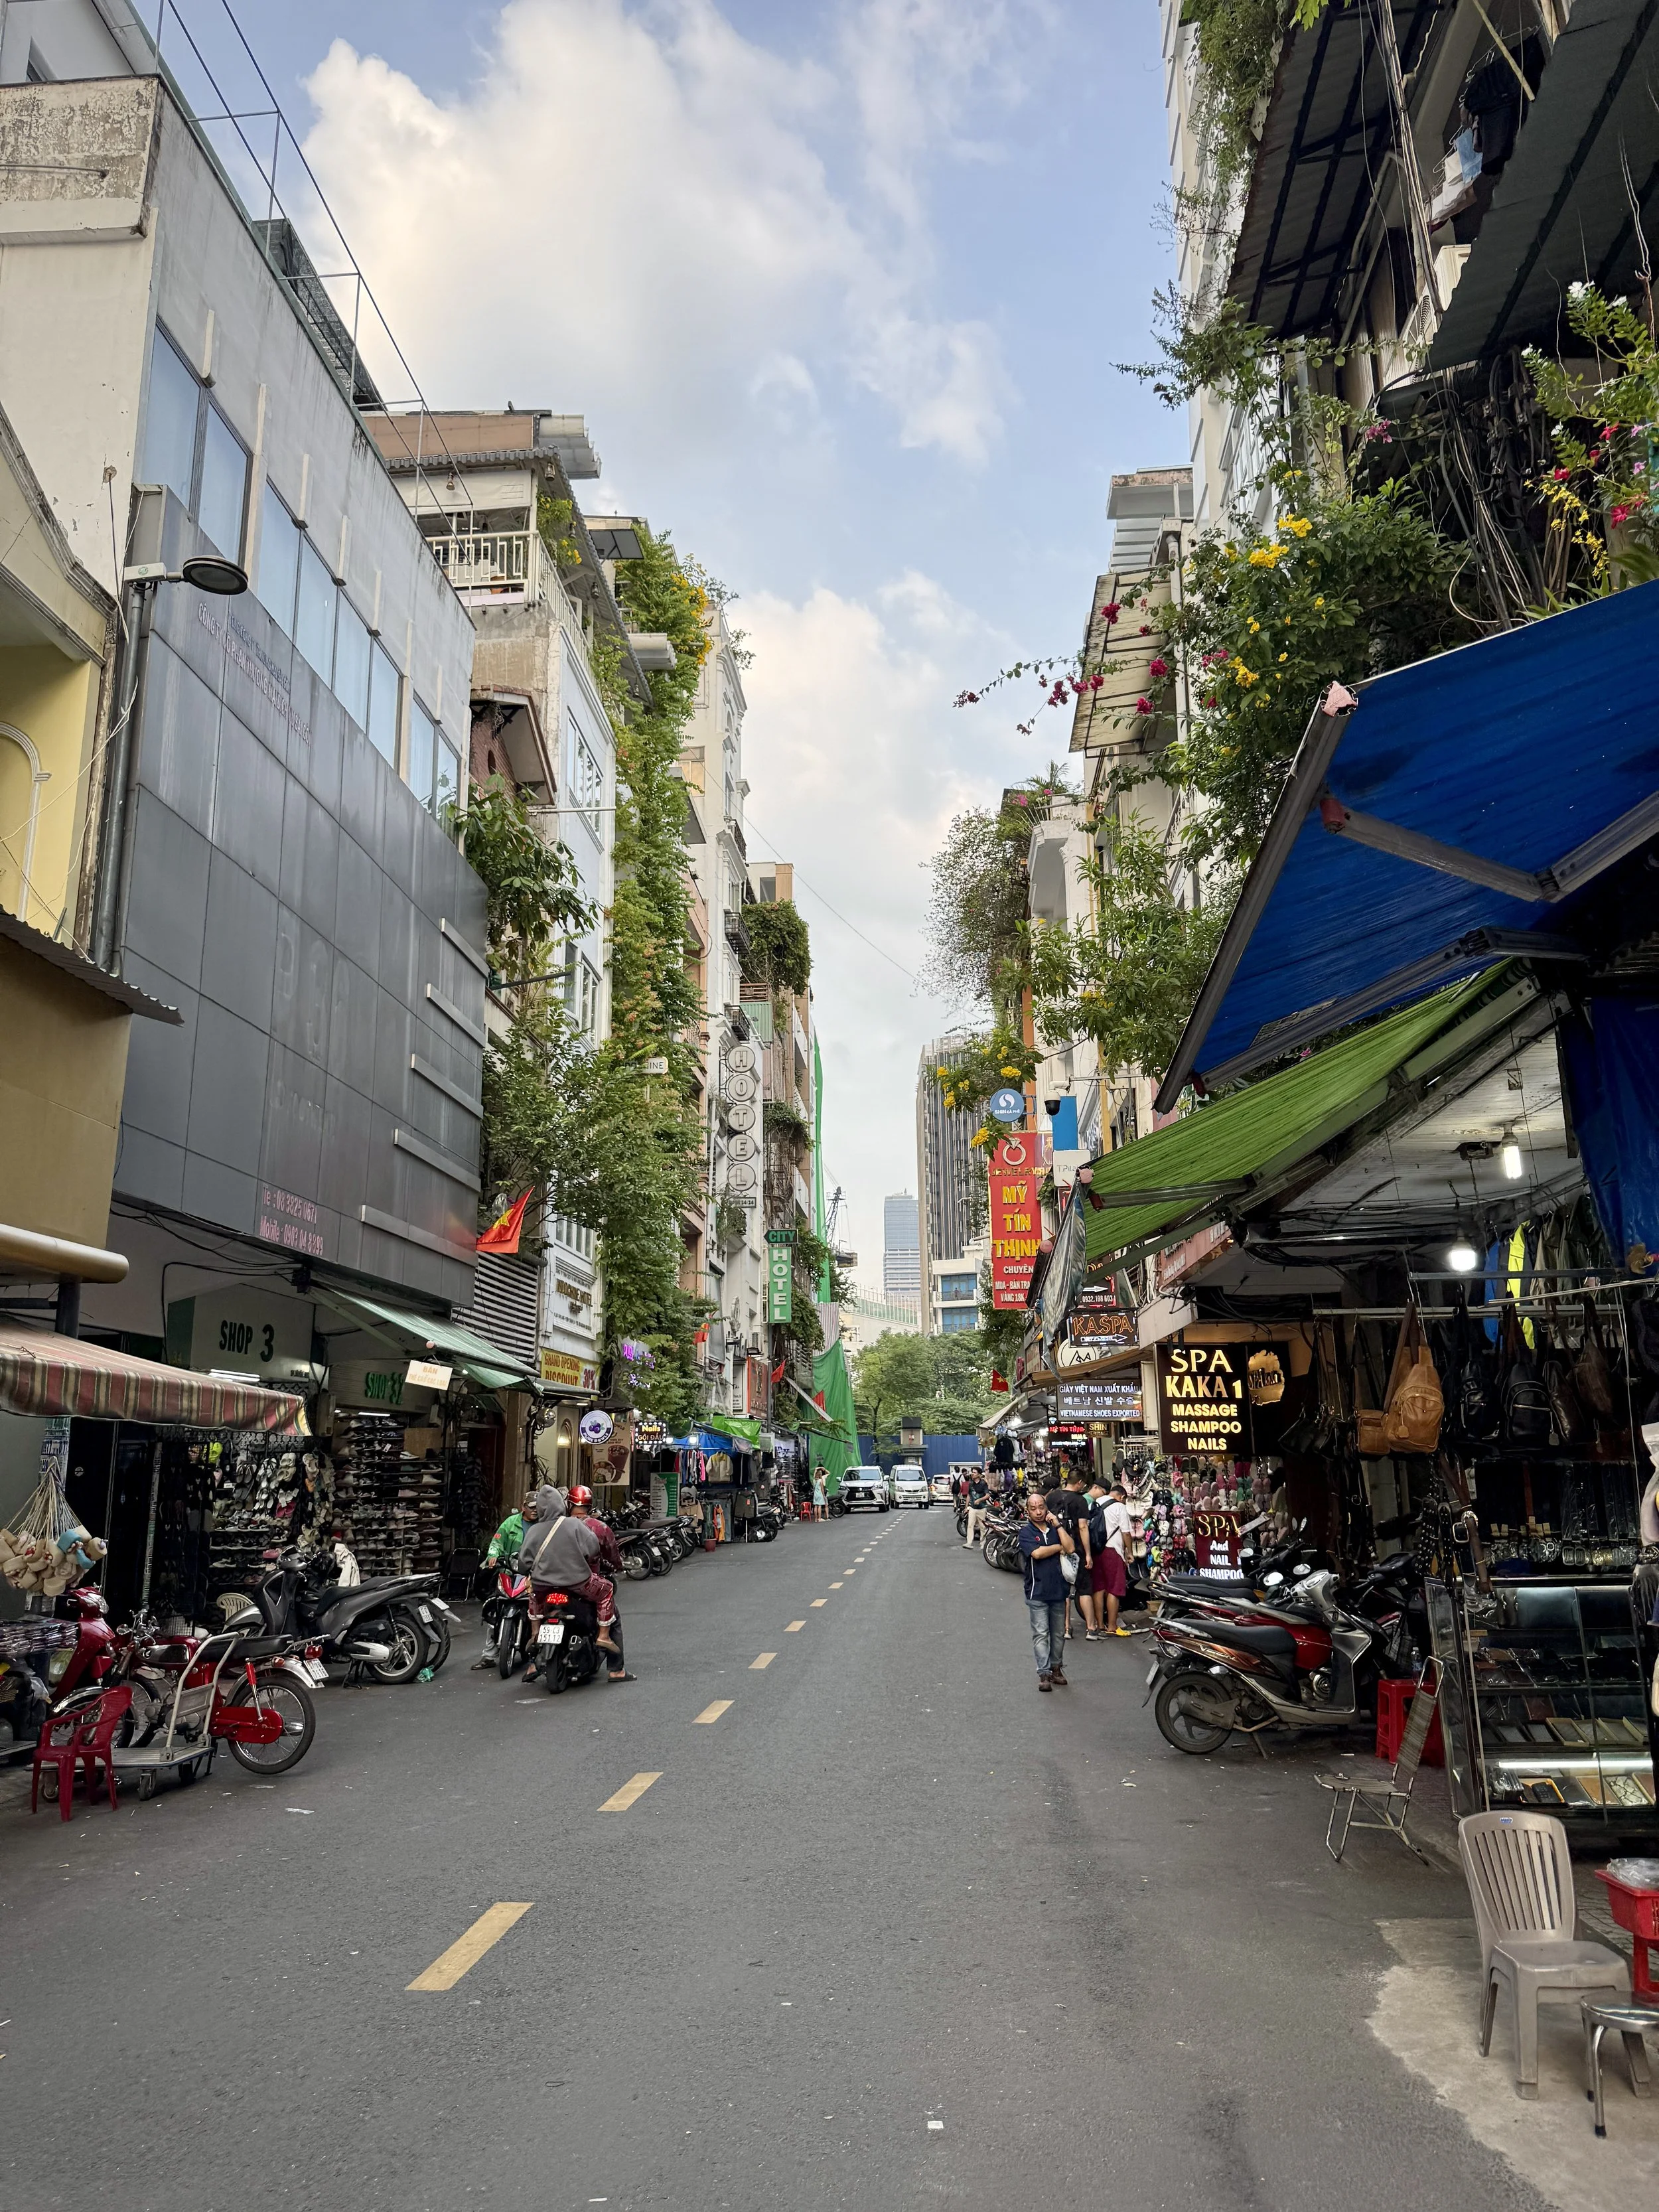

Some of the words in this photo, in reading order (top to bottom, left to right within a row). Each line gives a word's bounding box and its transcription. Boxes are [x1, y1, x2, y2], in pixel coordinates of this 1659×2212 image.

[735, 1051, 747, 1186] HOTEL
[1003, 1180, 1027, 1204] MỸ
[287, 1194, 303, 1218] 3825
[303, 1201, 317, 1224] 0671
[1003, 1209, 1031, 1232] TÍN
[284, 1223, 298, 1248] 0903
[308, 1232, 323, 1256] 8899
[769, 1231, 796, 1242] CITY
[1003, 1264, 1033, 1274] CHUYÊN
[772, 1249, 788, 1320] HOTEL
[995, 1282, 1005, 1290] MUA
[1009, 1279, 1020, 1290] BÁN
[1001, 1291, 1014, 1302] VÀNG
[1073, 1315, 1133, 1336] KASPA
[220, 1319, 253, 1355] SHOP
[259, 1324, 275, 1363] 3
[545, 1353, 561, 1367] GRAND
[561, 1357, 580, 1372] OPENING
[1171, 1349, 1233, 1372] SPA
[545, 1370, 578, 1386] DISCOUNT
[583, 1368, 596, 1390] 30%
[1060, 1384, 1073, 1393] GIÀY
[1075, 1384, 1088, 1394] VIỆT
[1104, 1382, 1120, 1393] XUẤT
[1121, 1382, 1138, 1393] KHẨU
[1165, 1376, 1228, 1398] KAKA
[1232, 1379, 1242, 1398] 1
[1064, 1396, 1092, 1406] 베트남
[1095, 1396, 1114, 1406] 신발
[1173, 1404, 1238, 1416] MASSAGE
[1171, 1421, 1242, 1434] SHAMPOO
[1188, 1438, 1227, 1450] NAILS
[1196, 1514, 1240, 1538] SPA
[1210, 1540, 1228, 1551] And
[1210, 1554, 1231, 1566] NAIL
